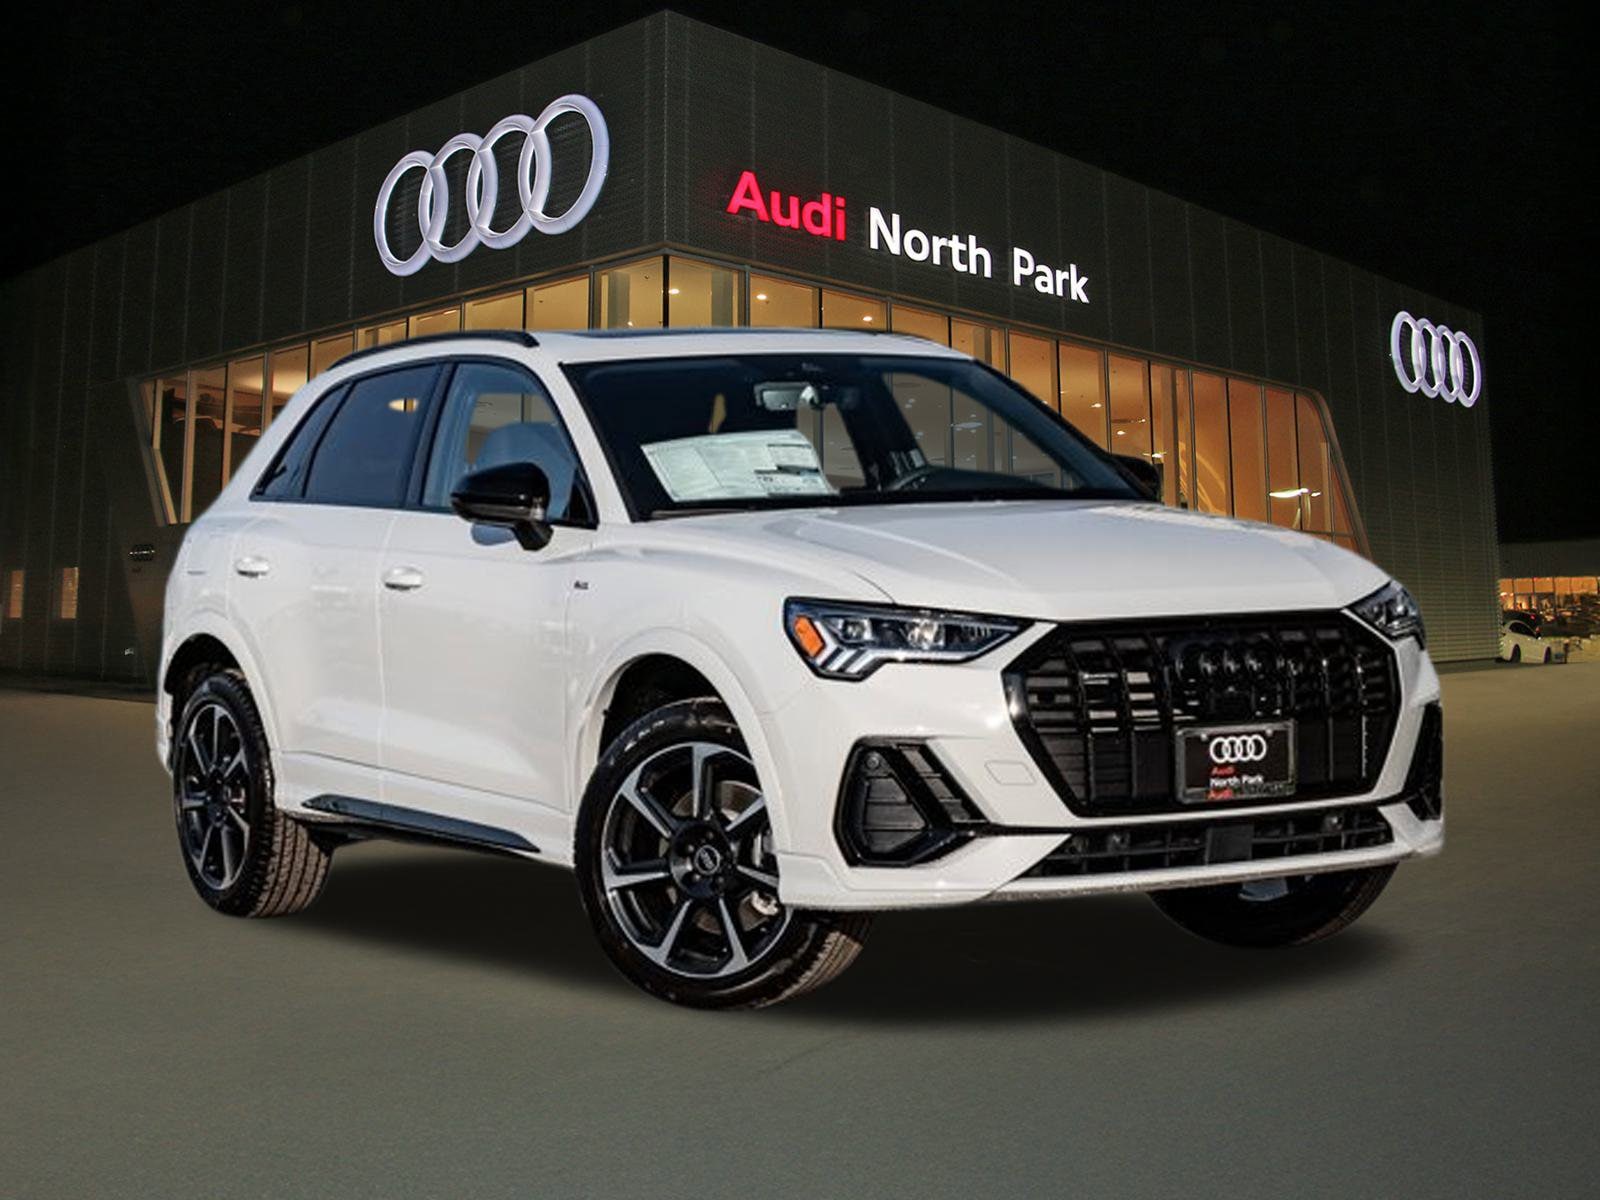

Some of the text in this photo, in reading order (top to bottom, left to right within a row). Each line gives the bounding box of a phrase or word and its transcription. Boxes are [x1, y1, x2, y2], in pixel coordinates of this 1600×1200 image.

[726, 171, 1090, 303] Audi North Park
[1210, 774, 1264, 788] North Park
